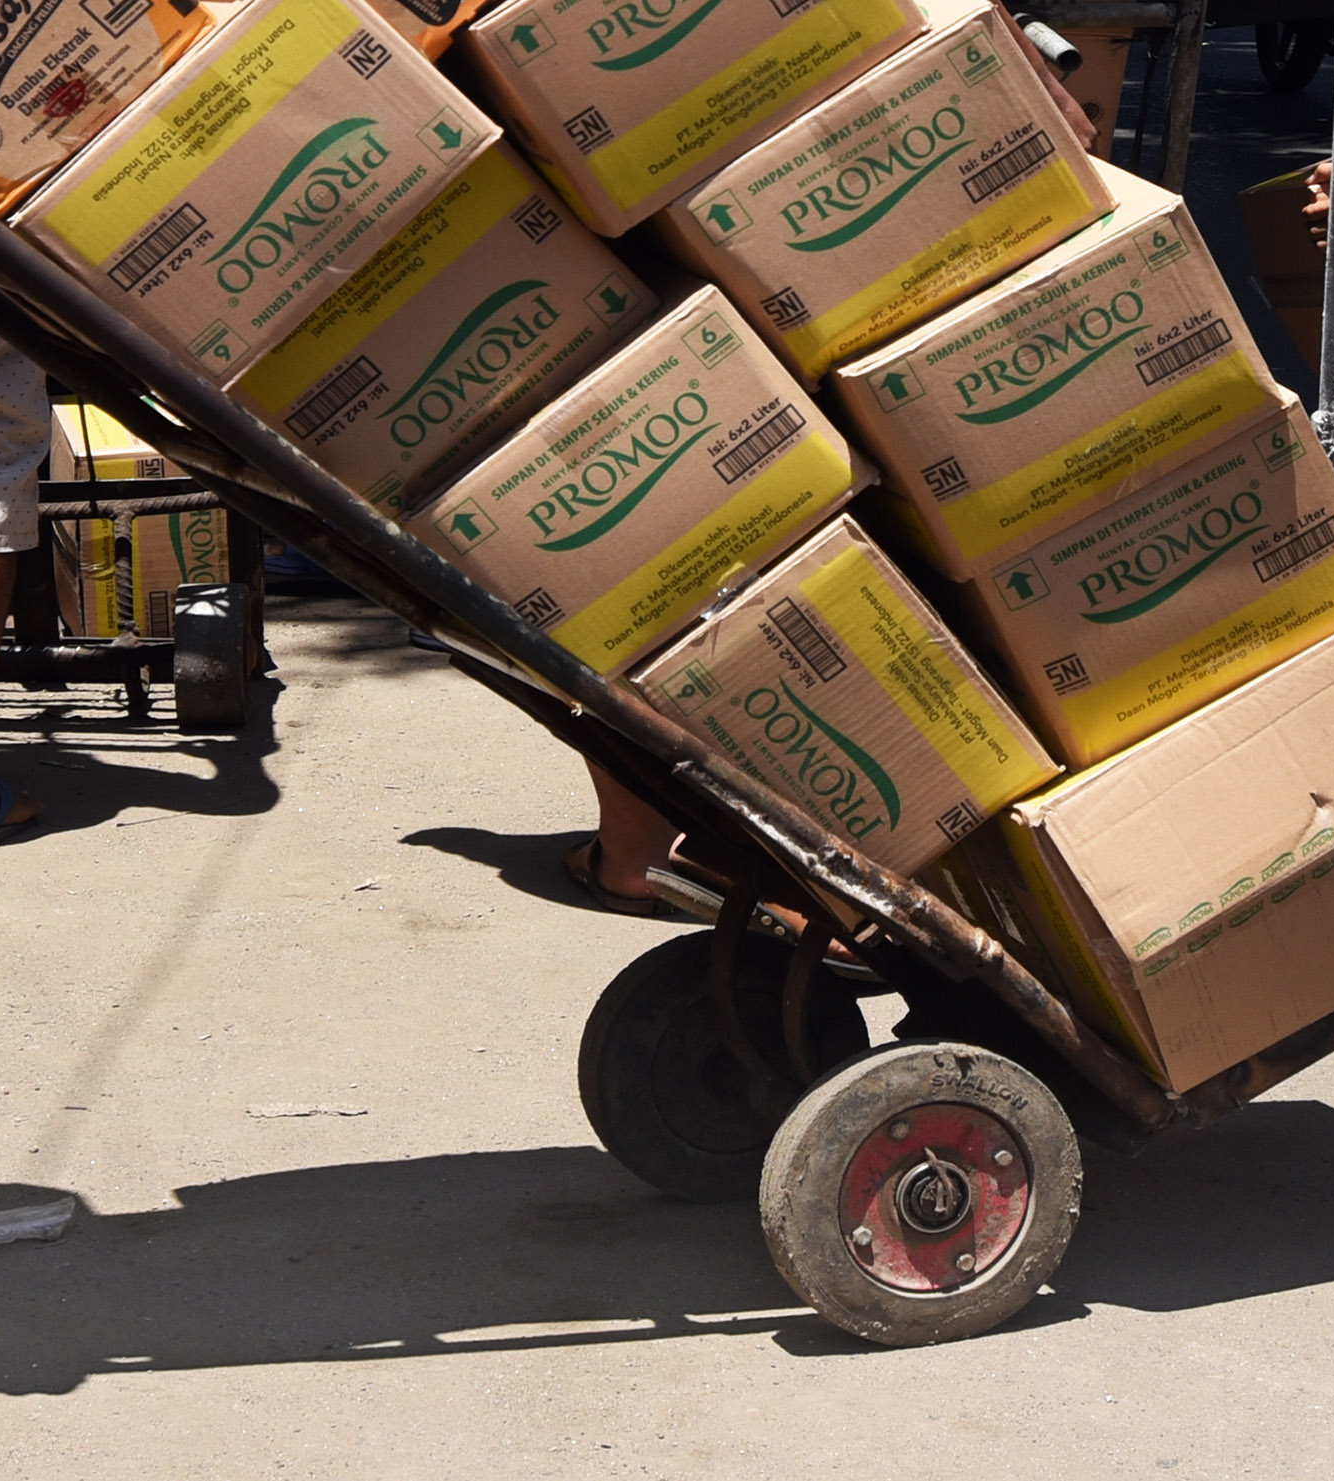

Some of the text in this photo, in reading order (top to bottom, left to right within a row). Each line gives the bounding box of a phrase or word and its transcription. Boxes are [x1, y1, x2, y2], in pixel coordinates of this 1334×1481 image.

[6, 20, 40, 61] DAGING
[18, 42, 101, 118] Daging Ayam
[42, 25, 94, 72] Ekstrak
[567, 110, 607, 146] SNI
[779, 103, 964, 234] PROMOO
[138, 229, 214, 297] Isi: 6x2 Liter
[214, 134, 388, 299] PROMOO
[387, 296, 558, 452] PROMOO
[953, 286, 1144, 405] PROMOO
[1132, 310, 1213, 356] Isi: 6x2 Liter
[491, 357, 680, 499] SIMPAN DI TEMPAT SEJUK & KERING
[526, 387, 708, 534] PROMOO
[541, 403, 650, 488] MINYAK GORENG SAWIT
[705, 397, 782, 456] Isi: 6x2 Liter
[925, 460, 964, 493] SNI
[604, 491, 813, 651] Daan Mogot Tangerang 15122, Indonesia
[629, 504, 773, 616] PT. Mahakarya Sentra Nabati
[656, 526, 728, 579] Dikemas oleh:
[1078, 487, 1262, 604] PROMOO
[742, 688, 885, 842] PROMOO
